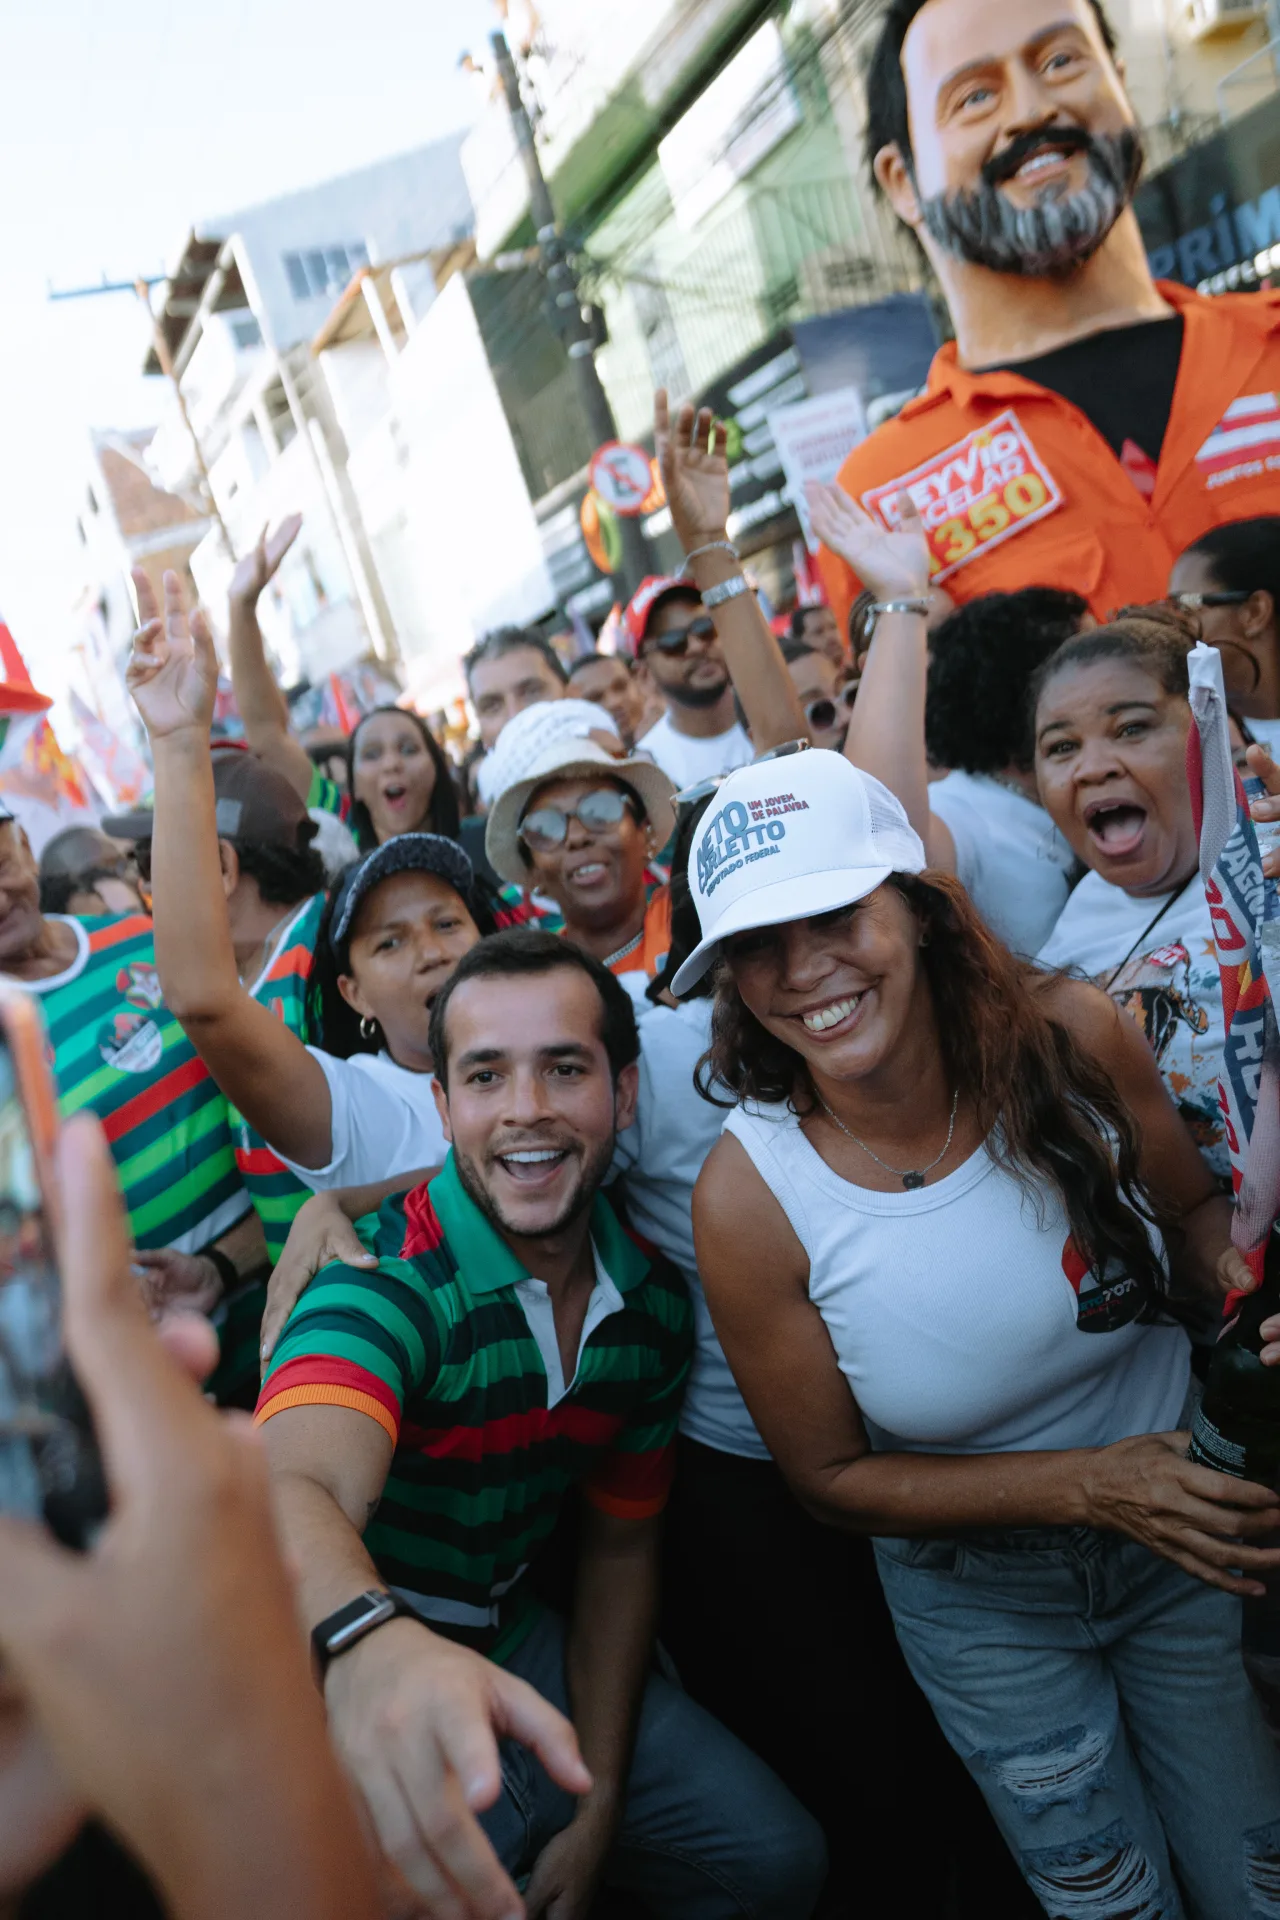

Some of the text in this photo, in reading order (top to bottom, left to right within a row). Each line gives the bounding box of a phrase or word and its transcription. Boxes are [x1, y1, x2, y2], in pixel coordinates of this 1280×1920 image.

[747, 793, 795, 811] UM JOVEM
[751, 801, 810, 821] DE PALAVRA
[745, 845, 781, 864] FEDERAL
